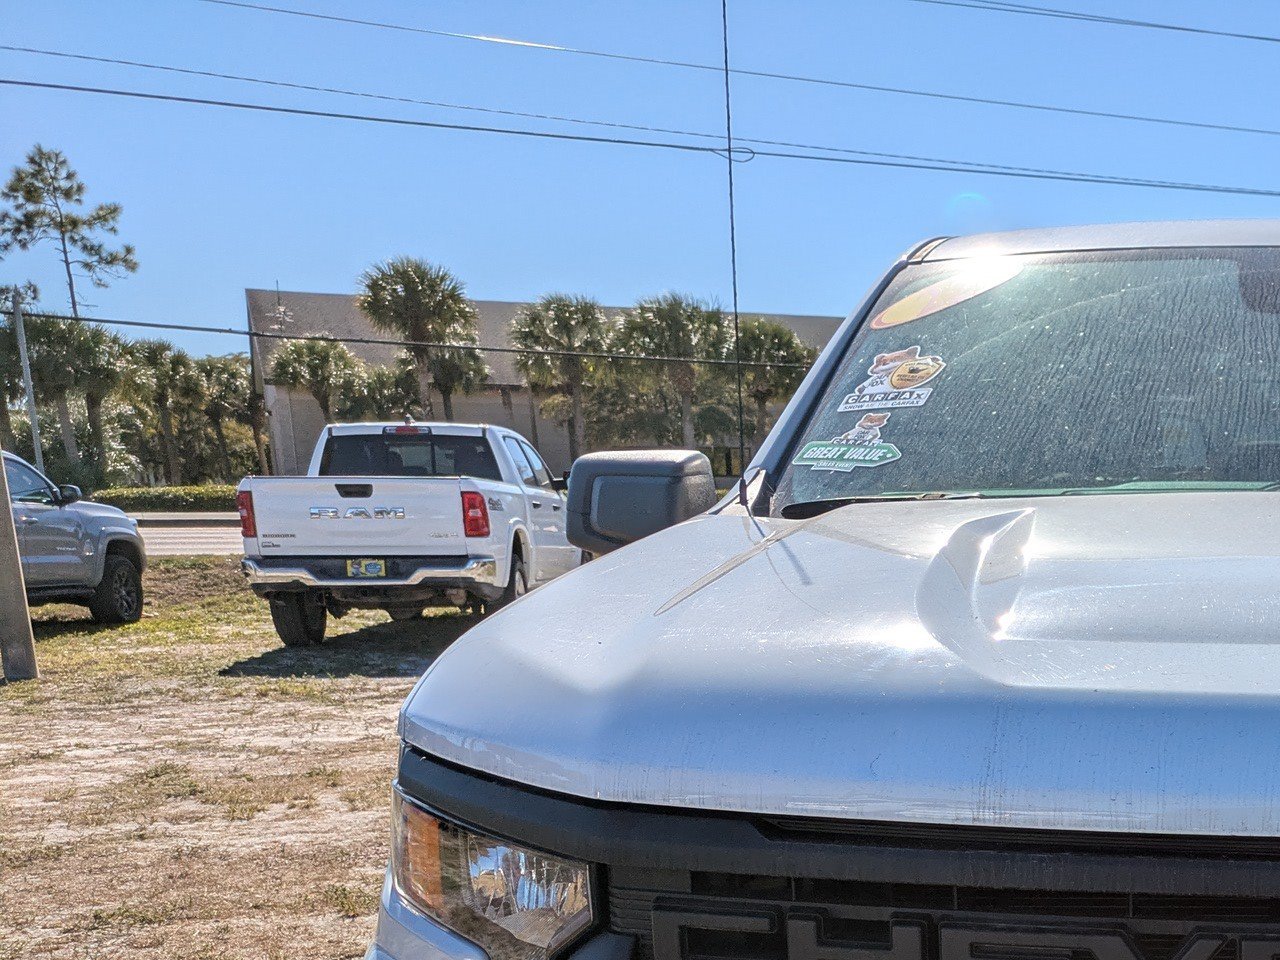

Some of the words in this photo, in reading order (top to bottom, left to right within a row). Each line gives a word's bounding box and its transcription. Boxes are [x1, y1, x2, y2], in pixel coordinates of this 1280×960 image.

[847, 391, 926, 405] CARFAX
[803, 446, 847, 459] GREAT
[843, 446, 888, 461] VALUE
[310, 506, 405, 519] RAM
